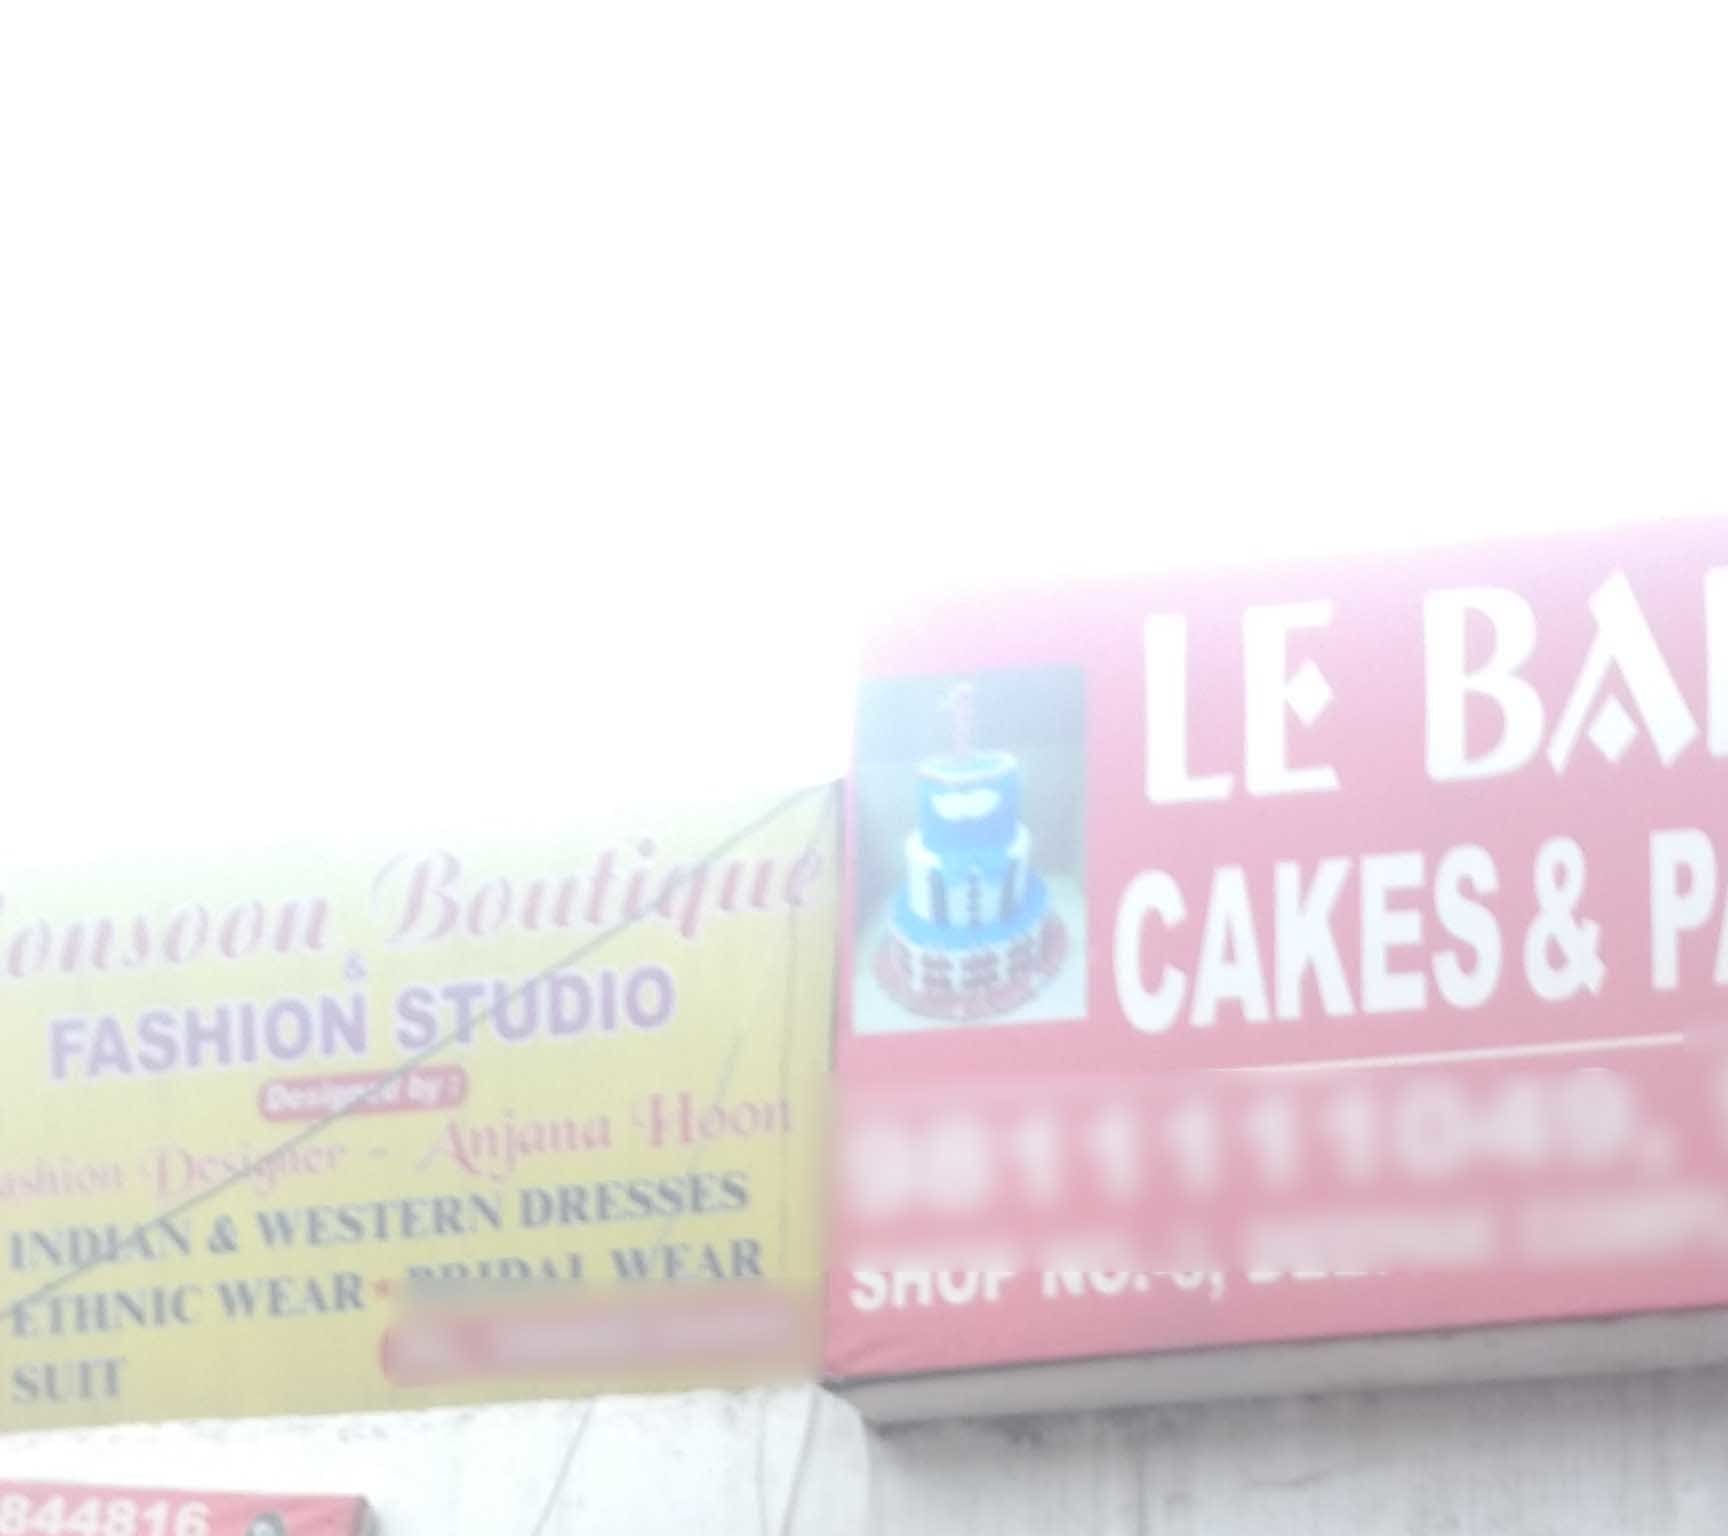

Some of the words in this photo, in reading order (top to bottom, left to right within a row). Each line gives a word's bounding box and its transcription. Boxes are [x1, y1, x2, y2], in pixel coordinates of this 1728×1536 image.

[1144, 599, 1340, 804] LE
[0, 850, 328, 978] onsoon
[370, 838, 823, 943] Boutique
[1113, 842, 1504, 1034] CAKES
[1524, 836, 1606, 1002] &
[48, 993, 367, 1079] FASHION
[396, 967, 675, 1050] STUDIO
[8, 1213, 192, 1273] INDIAN
[206, 1213, 241, 1256] &
[256, 1192, 503, 1248] WESTERN
[516, 1169, 752, 1229] DRESSES
[8, 1283, 204, 1339] ETHNIC
[215, 1270, 367, 1322] WEAR
[9, 1355, 128, 1406] SUIT
